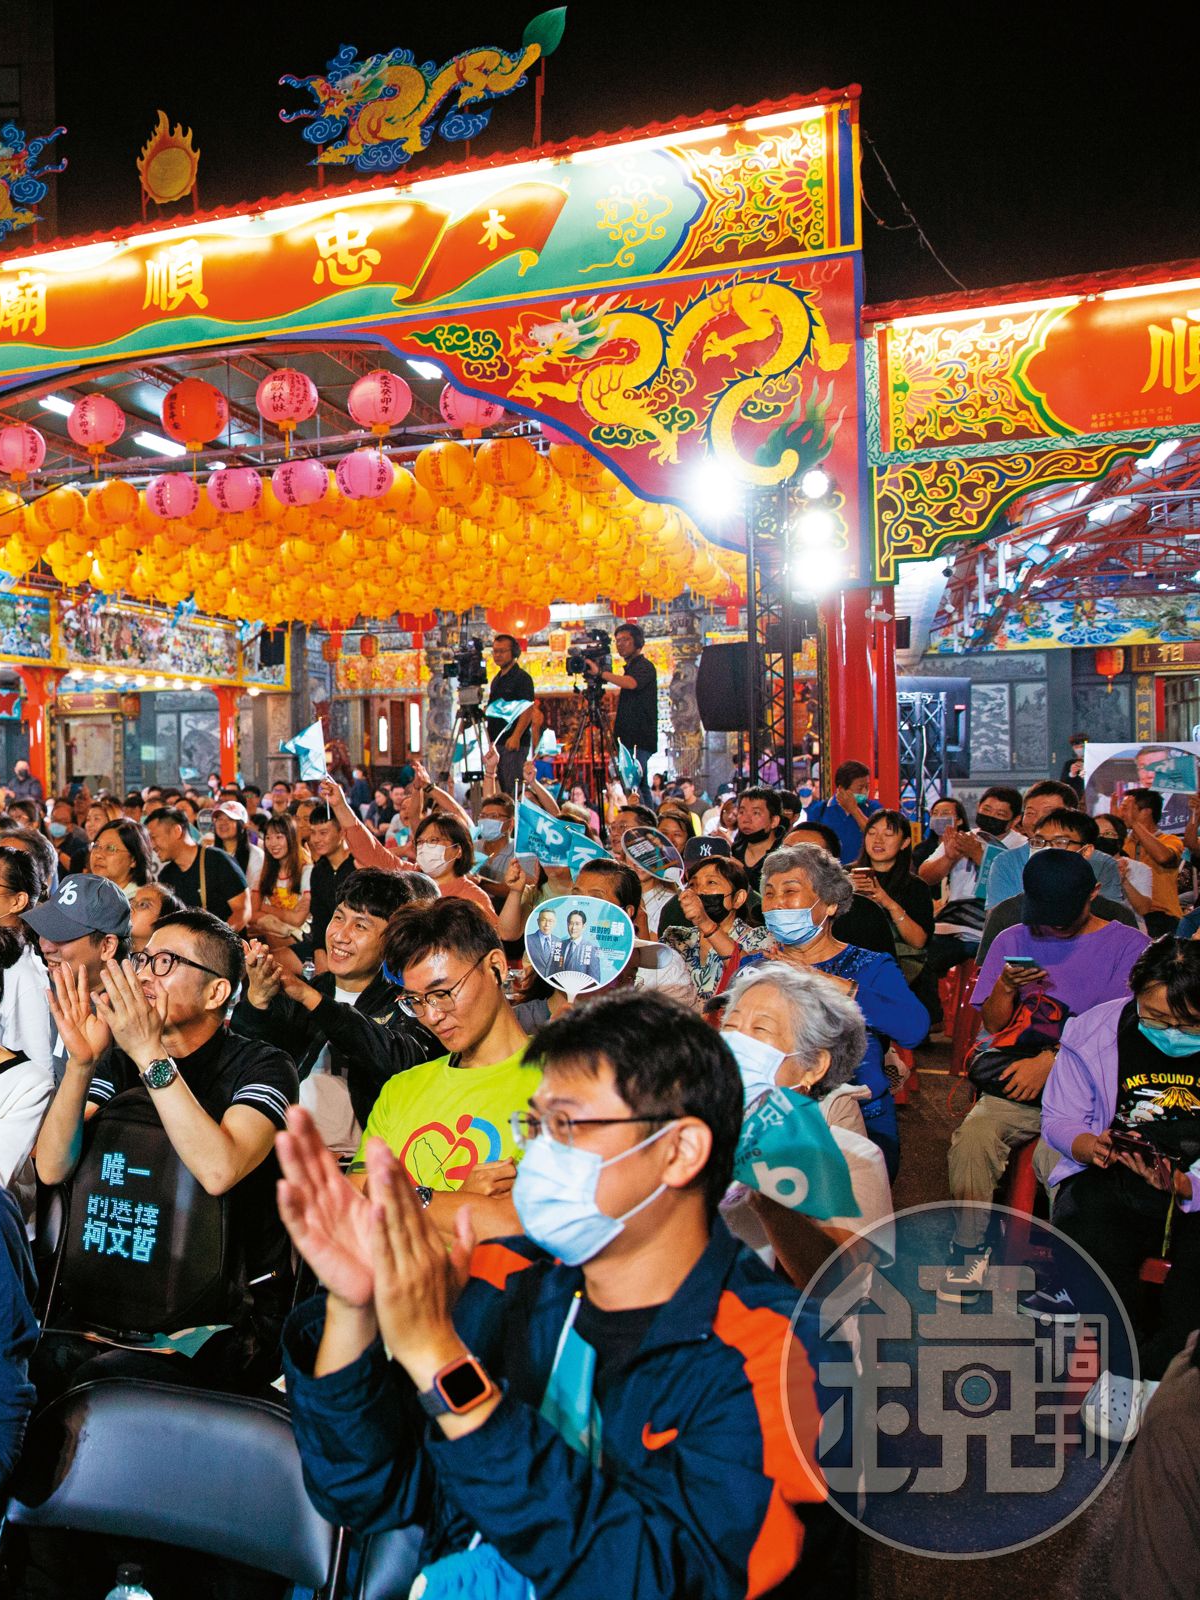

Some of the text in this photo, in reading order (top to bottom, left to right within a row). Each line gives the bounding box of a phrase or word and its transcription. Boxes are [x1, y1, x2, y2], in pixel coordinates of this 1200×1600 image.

[1150, 1073, 1194, 1086] SOUND
[101, 1152, 151, 1186] 唯一
[83, 1218, 156, 1262] 柯文哲
